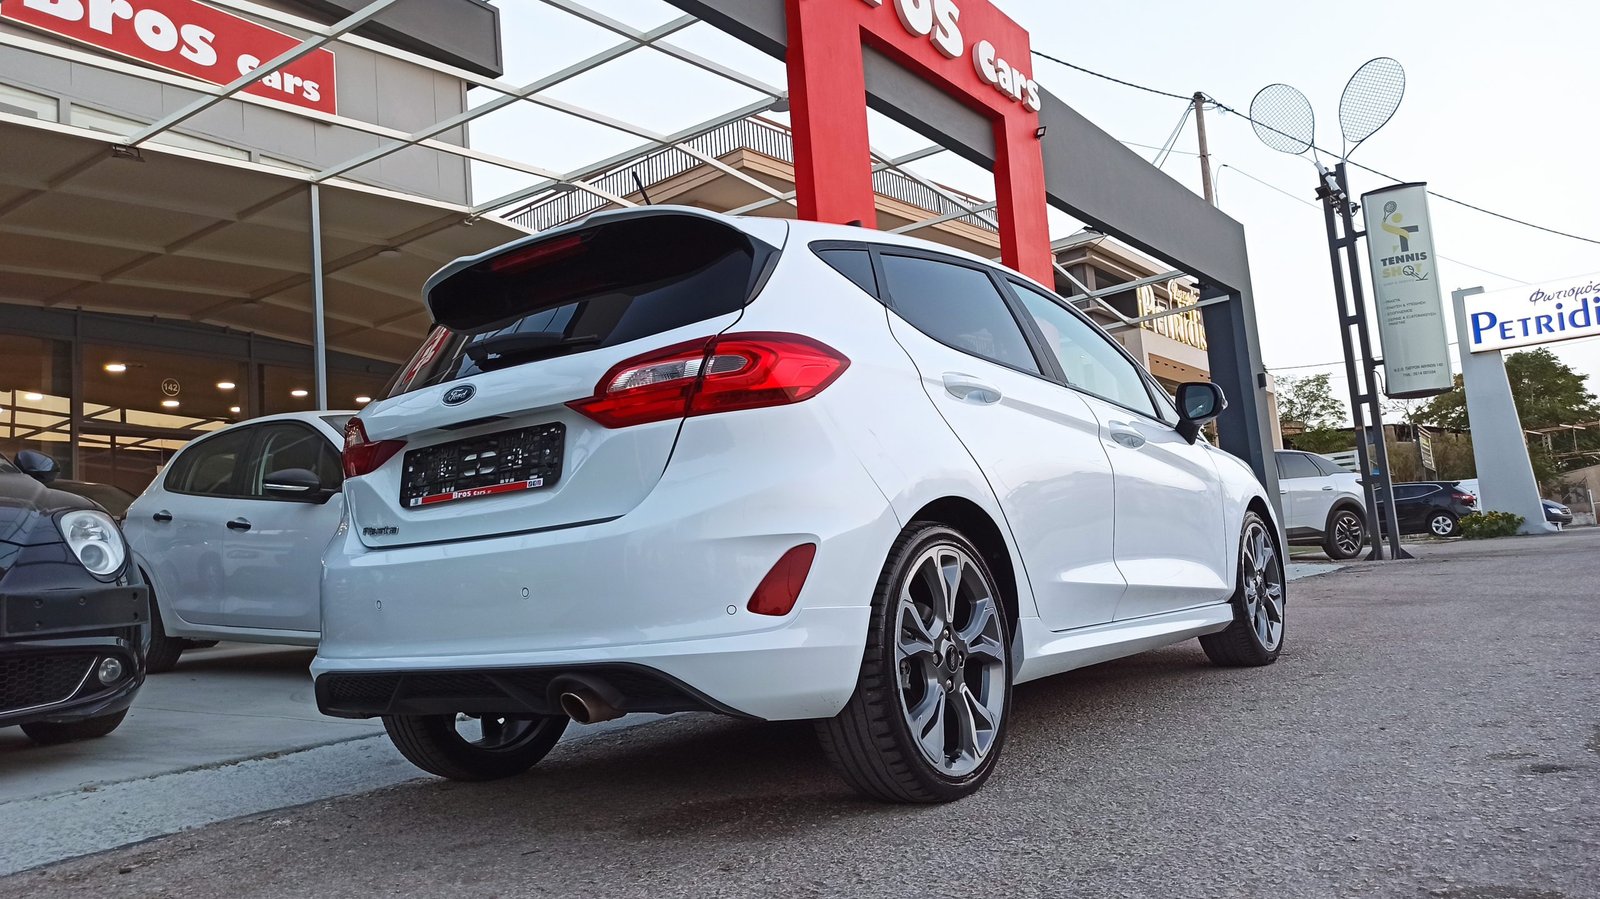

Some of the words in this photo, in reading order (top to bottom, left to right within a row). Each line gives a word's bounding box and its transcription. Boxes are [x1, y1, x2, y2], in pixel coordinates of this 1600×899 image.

[23, 0, 218, 66] ros
[973, 40, 1041, 112] Cars
[1380, 251, 1428, 267] TENNIS
[163, 382, 178, 392] 142
